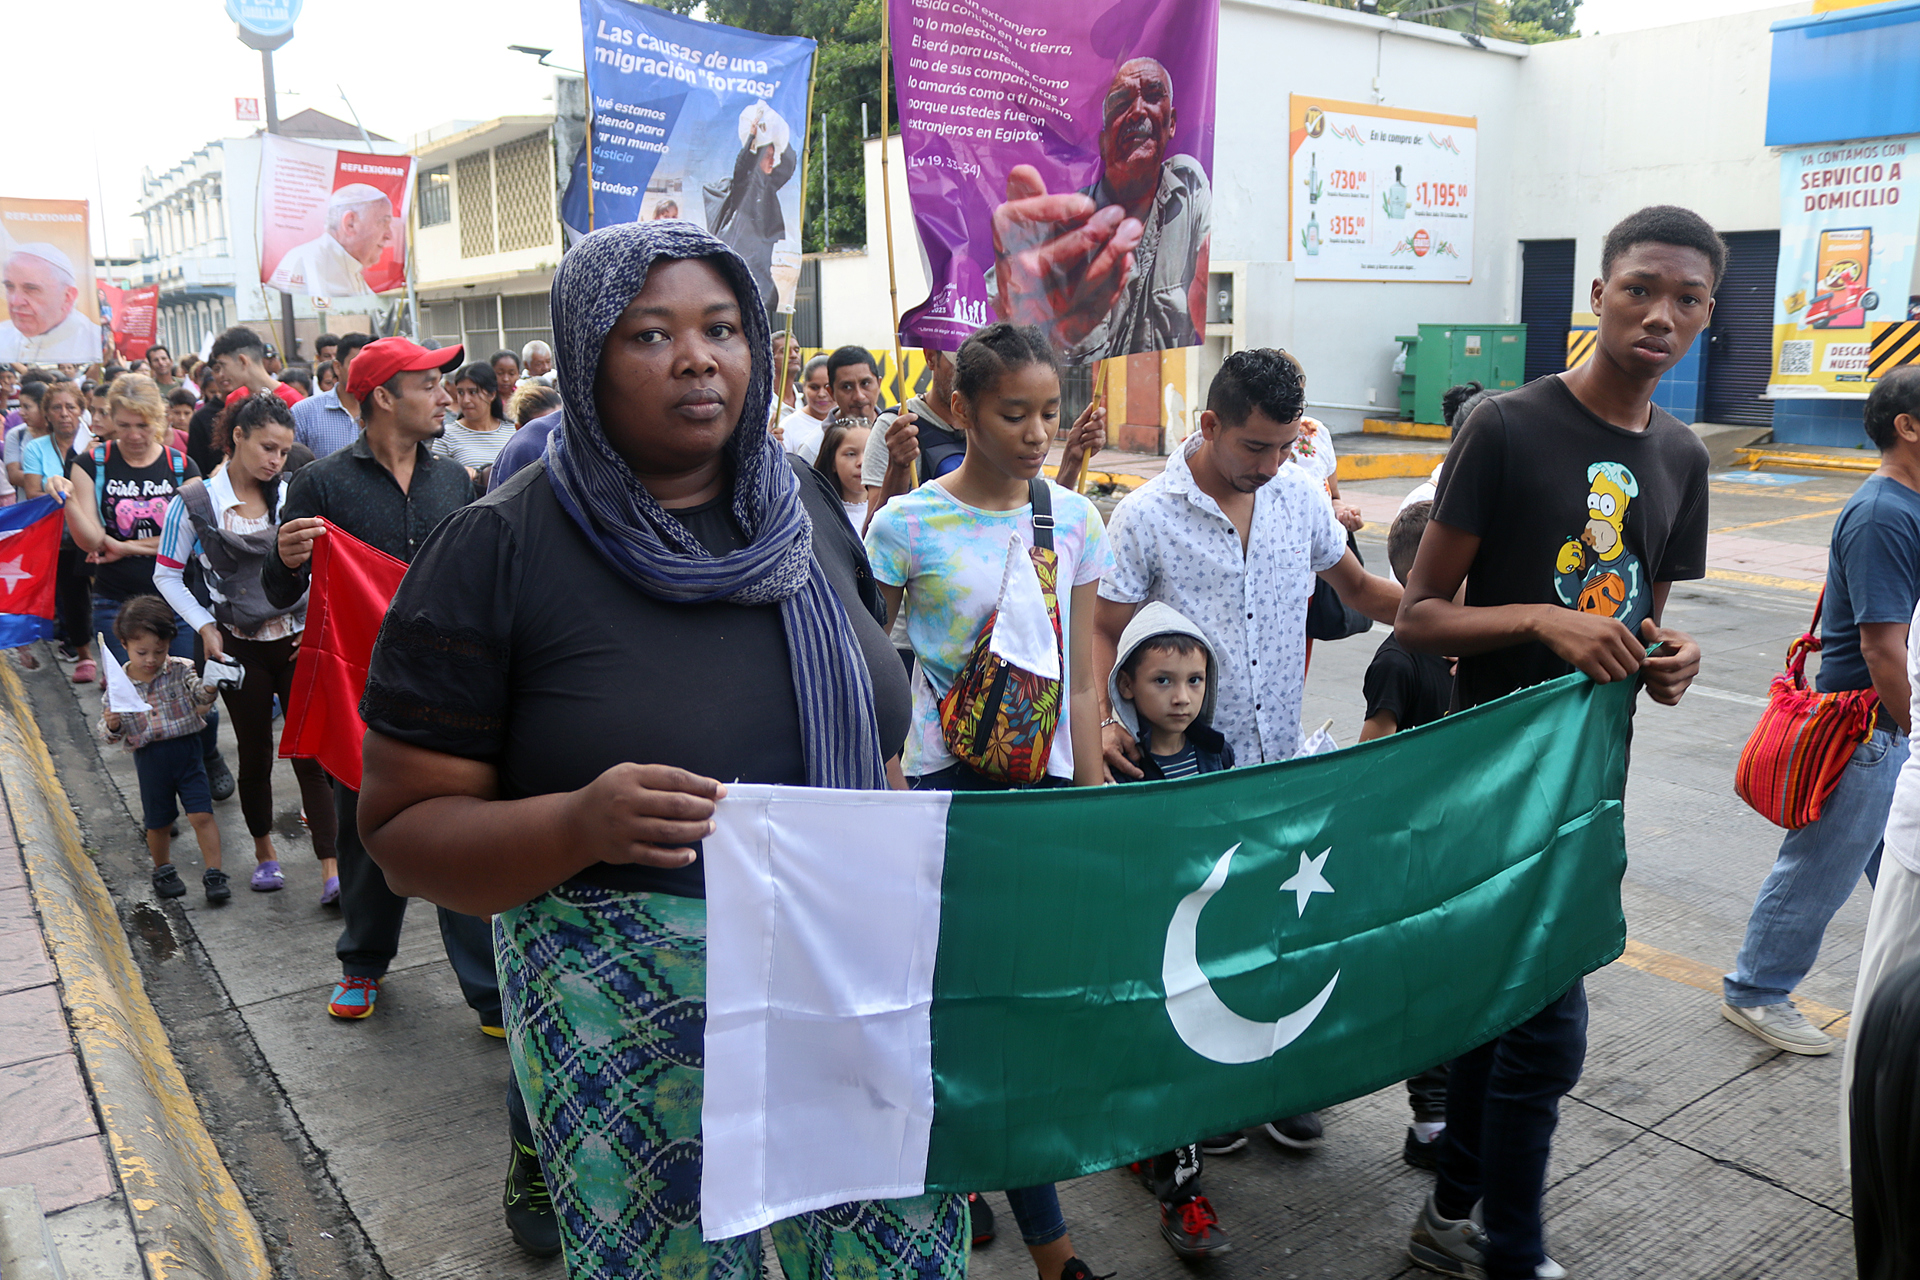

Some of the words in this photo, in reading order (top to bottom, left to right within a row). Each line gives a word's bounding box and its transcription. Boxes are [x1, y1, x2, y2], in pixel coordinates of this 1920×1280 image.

[952, 4, 996, 32] contigo
[998, 30, 1012, 42] en
[1015, 38, 1028, 50] tu
[1030, 42, 1073, 56] tierra,
[982, 7, 1047, 36] extranjero
[912, 16, 924, 28] no
[926, 17, 938, 31] lo
[940, 22, 1012, 54] molestarás.
[596, 20, 634, 46] Las
[637, 32, 702, 64] causas
[704, 50, 728, 70] de
[730, 56, 768, 74] una
[595, 46, 696, 84] migración
[912, 34, 922, 48] El
[922, 36, 949, 52] será
[950, 44, 982, 58] para
[984, 49, 1030, 78] ustedes
[1032, 74, 1069, 90] como
[910, 56, 929, 70] uno
[931, 60, 948, 73] de
[950, 64, 972, 77] sus
[974, 68, 1058, 102] compatriotas
[1060, 96, 1069, 107] y
[908, 75, 918, 88] lo
[918, 80, 967, 96] amarás
[970, 87, 1004, 101] como
[1007, 92, 1016, 102] a
[1017, 92, 1028, 104] ti
[1029, 96, 1073, 122] mismo,
[614, 102, 666, 121] estamos
[908, 98, 948, 114] porque
[950, 104, 1001, 120] ustedes
[1004, 108, 1046, 127] fueron
[634, 123, 666, 137] para
[908, 118, 974, 137] extranjeros
[976, 128, 992, 138] en
[1370, 130, 1379, 140] En
[610, 134, 626, 146] un
[627, 138, 670, 154] mundo
[1801, 154, 1814, 166] YA
[1818, 146, 1878, 164] CONTAMOS
[1882, 144, 1906, 157] CON
[340, 162, 404, 176] REFLEXIONAR
[908, 155, 926, 170] (Lv
[927, 156, 944, 167] 19,
[946, 157, 981, 178] 33-34)
[1800, 164, 1883, 190] SERVICIO
[1888, 162, 1901, 180] A
[600, 182, 638, 197] todos?
[1330, 170, 1366, 190] $730.00
[1416, 182, 1468, 208] $1,195.00
[1804, 187, 1900, 212] DOMICILIO
[4, 212, 83, 222] REFLEXIONAR
[1330, 216, 1365, 235] $315.00
[106, 479, 140, 496] Girls
[142, 479, 174, 496] Rule
